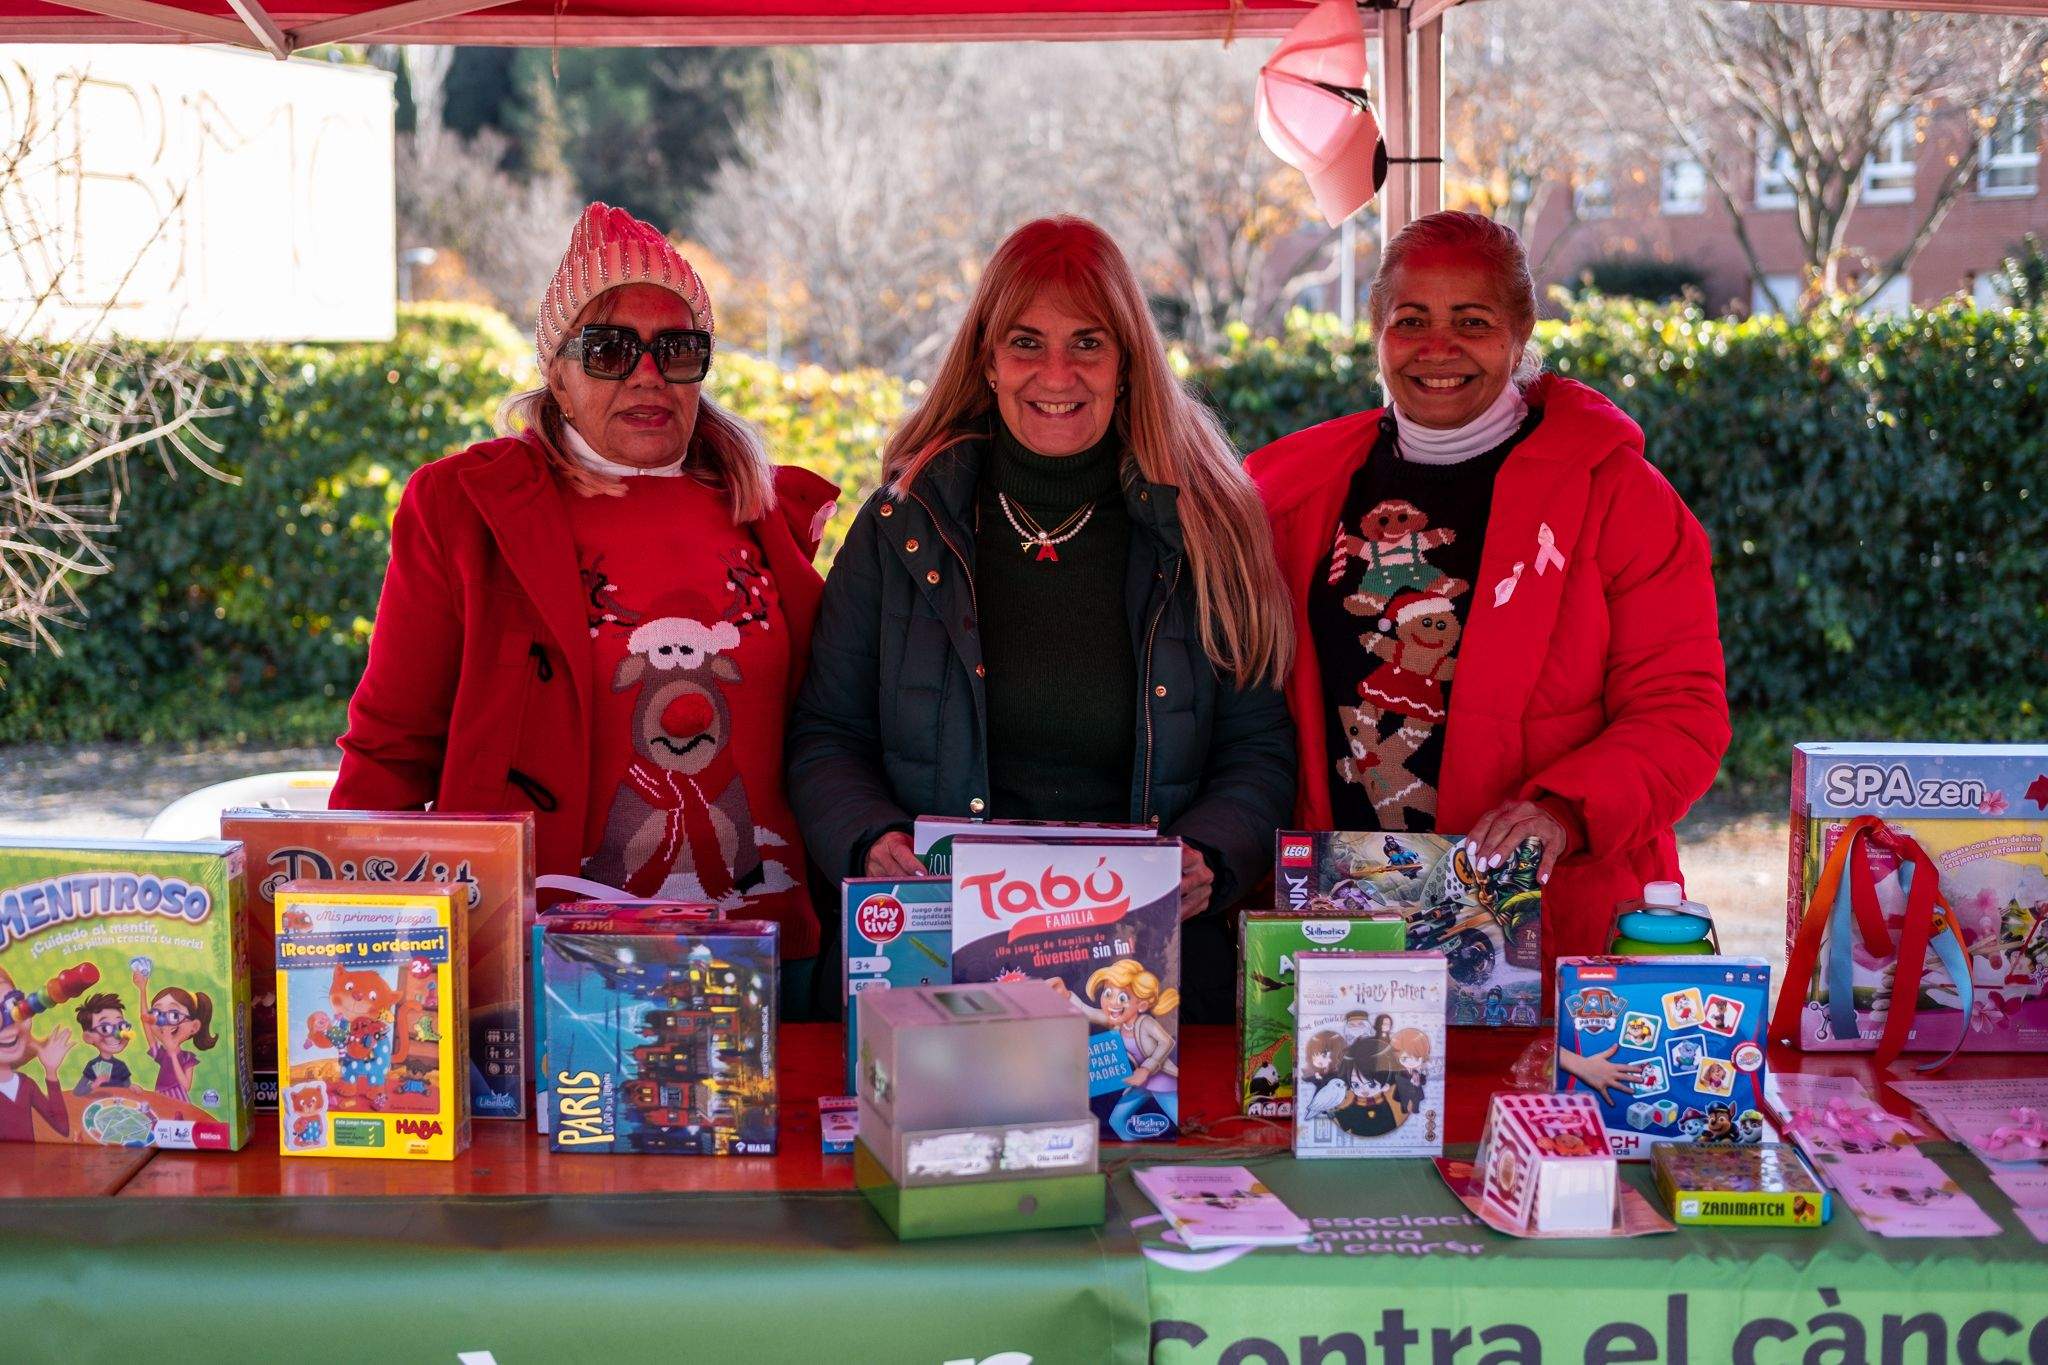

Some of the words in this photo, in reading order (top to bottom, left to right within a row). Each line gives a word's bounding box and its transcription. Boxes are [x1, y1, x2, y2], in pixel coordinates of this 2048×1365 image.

[1827, 765, 1914, 807] SPA
[1917, 779, 1986, 808] zen
[1283, 846, 1310, 857] LEGO
[960, 856, 1124, 920] Tabú
[0, 873, 210, 948] MENTIROSO
[863, 905, 899, 920] Play
[912, 907, 932, 915] Juego
[316, 911, 341, 923] Mis
[343, 911, 394, 926] primeros
[396, 913, 432, 927] juegos
[864, 920, 897, 933] tive
[1045, 910, 1095, 929] FAMILIA
[92, 924, 106, 935] al
[1305, 925, 1346, 936] Skillmatics
[281, 942, 353, 958] ¡Recoger
[358, 944, 368, 958] y
[372, 935, 444, 953] ordenar!
[1032, 947, 1089, 968] diversión
[1093, 941, 1111, 959] sin
[1114, 938, 1137, 956] fin!
[411, 961, 430, 974] 2+
[855, 961, 870, 970] 3+
[1356, 982, 1387, 1004] Harry
[1390, 980, 1426, 1003] Potter
[1565, 992, 1628, 1018] PAW
[1091, 1053, 1118, 1069] PARA
[1089, 1063, 1127, 1083] PADRES
[558, 1070, 615, 1145] PARIS
[396, 1119, 442, 1139] HABA
[1129, 1114, 1165, 1128] Hasbro
[1702, 1202, 1785, 1216] ZANIMATCH
[1313, 1227, 1423, 1242] ontra
